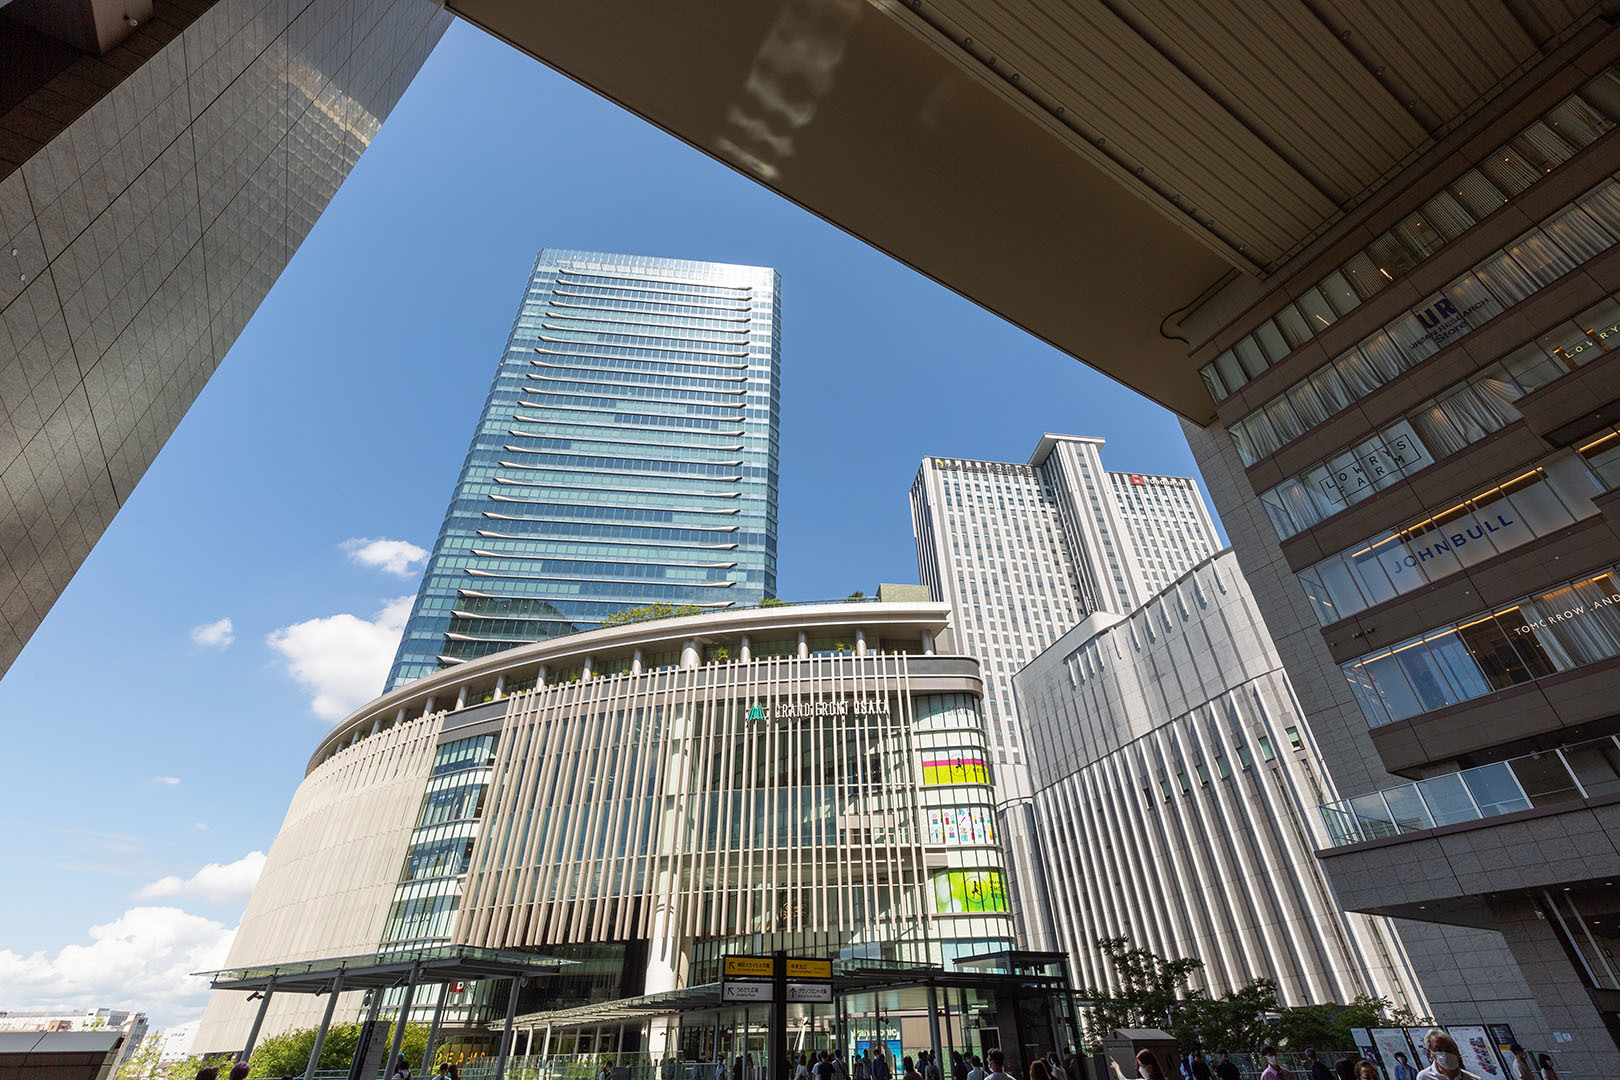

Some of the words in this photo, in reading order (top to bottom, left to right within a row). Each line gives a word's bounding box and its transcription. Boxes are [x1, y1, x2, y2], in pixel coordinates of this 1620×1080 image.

[1417, 298, 1457, 329] UR
[1434, 320, 1468, 344] Store
[1325, 440, 1407, 489] LOWRYS
[1393, 514, 1514, 574] JOHNBULL
[775, 702, 811, 718] GRAND
[815, 700, 849, 716] FRONT
[853, 699, 890, 714] OSAKA
